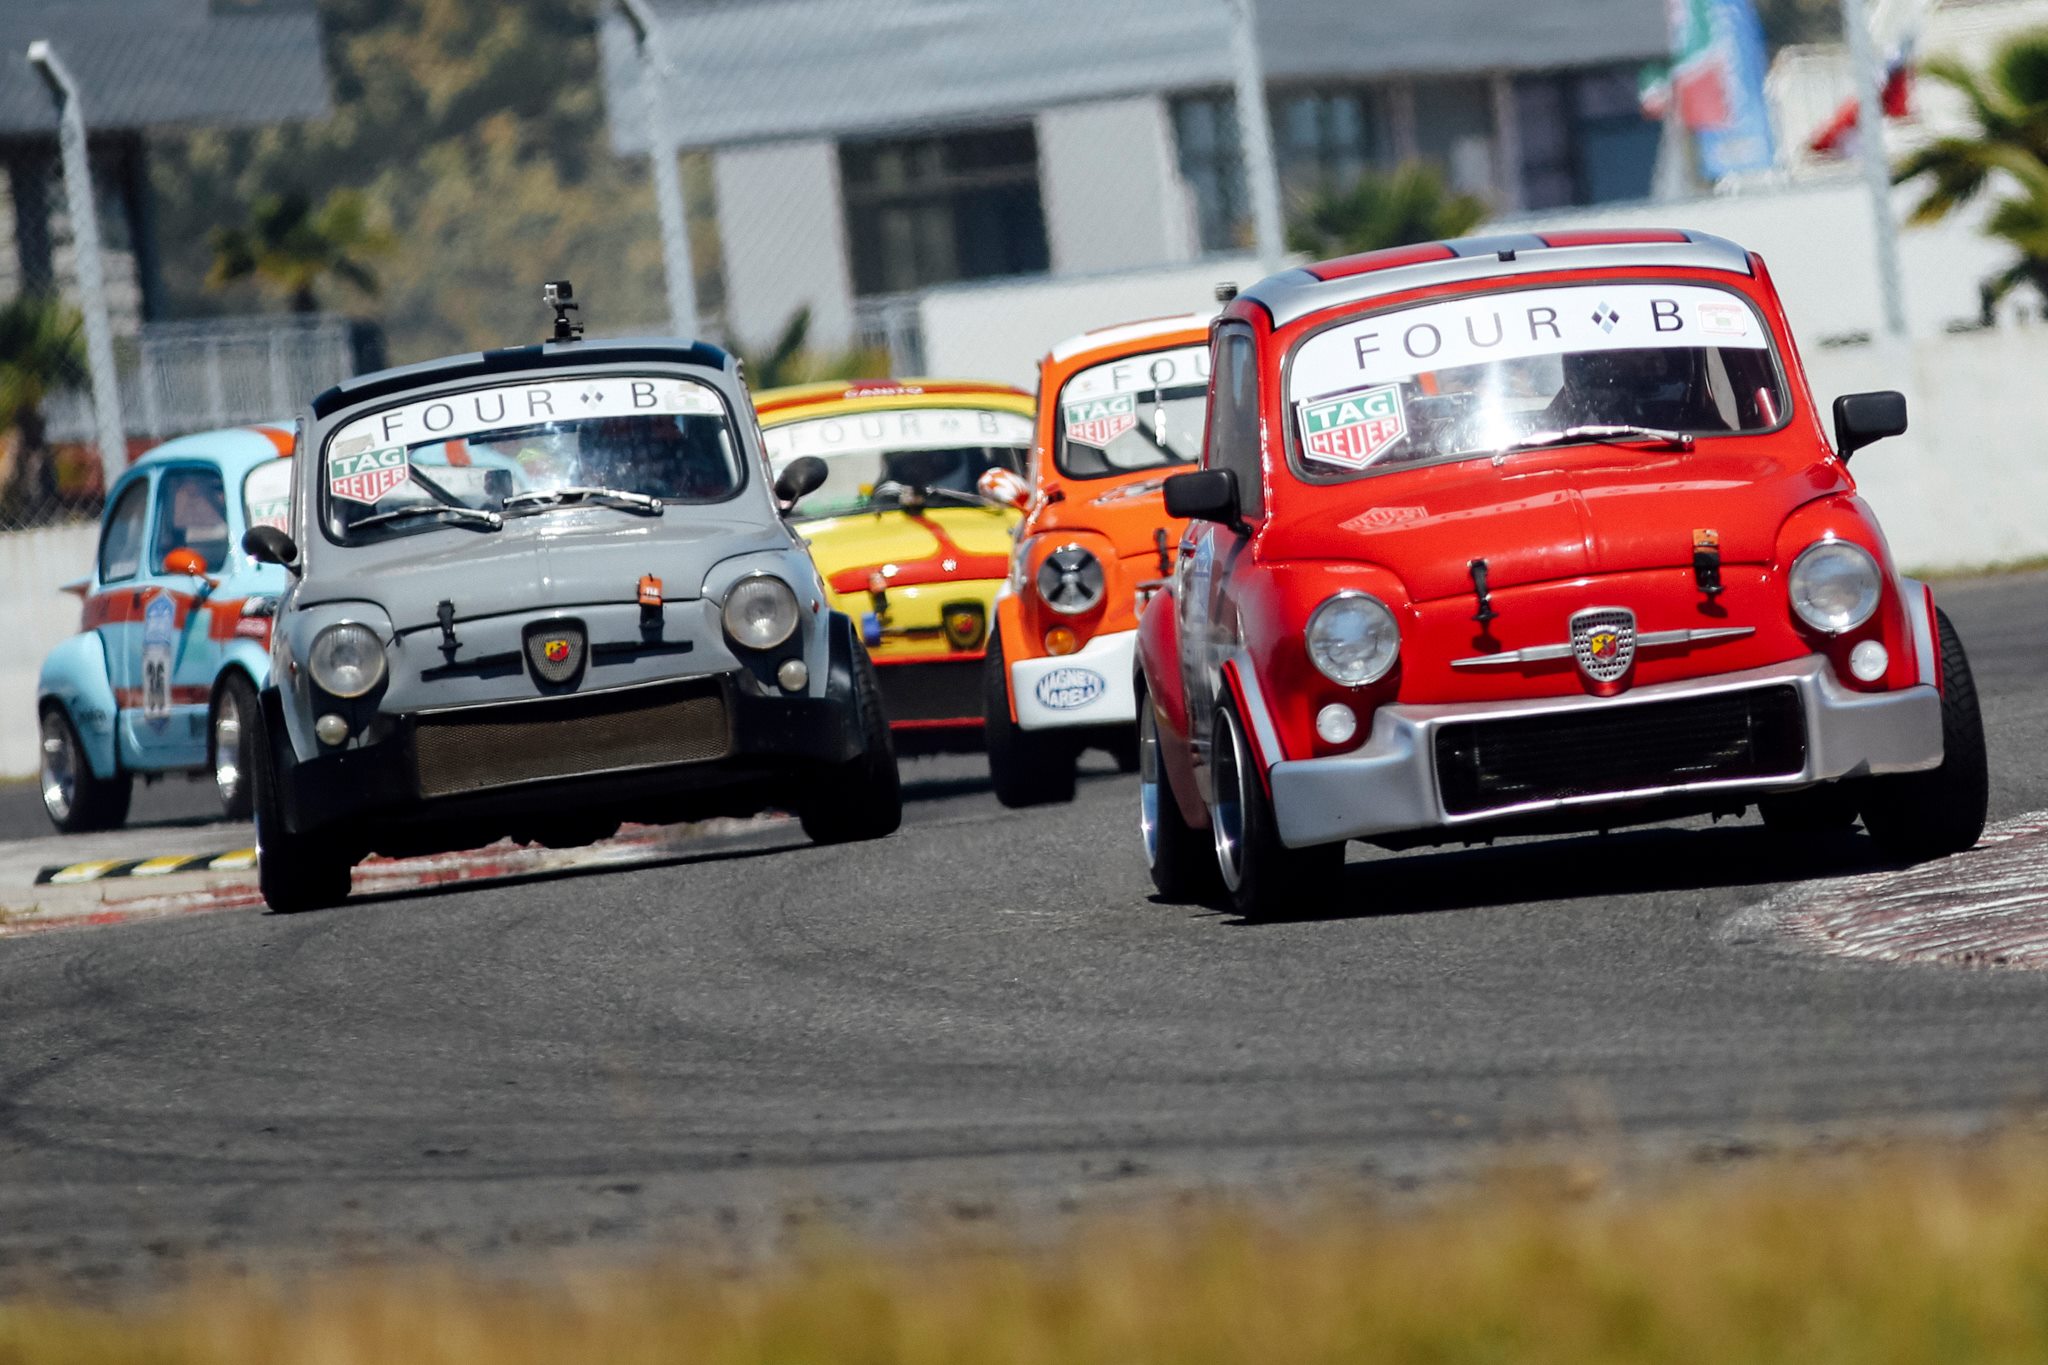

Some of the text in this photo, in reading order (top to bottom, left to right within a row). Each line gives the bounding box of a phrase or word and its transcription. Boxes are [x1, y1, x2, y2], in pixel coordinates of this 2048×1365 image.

[1354, 307, 1562, 370] FOUR
[1650, 298, 1684, 333] B
[381, 382, 658, 442] FOUR B
[1071, 396, 1131, 421] TAG
[1310, 394, 1388, 429] TAG
[787, 412, 999, 450] FOUR B
[1070, 414, 1135, 443] HEUER
[1311, 418, 1397, 459] HEUER
[335, 448, 401, 475] TAG
[335, 468, 405, 499] HEUER
